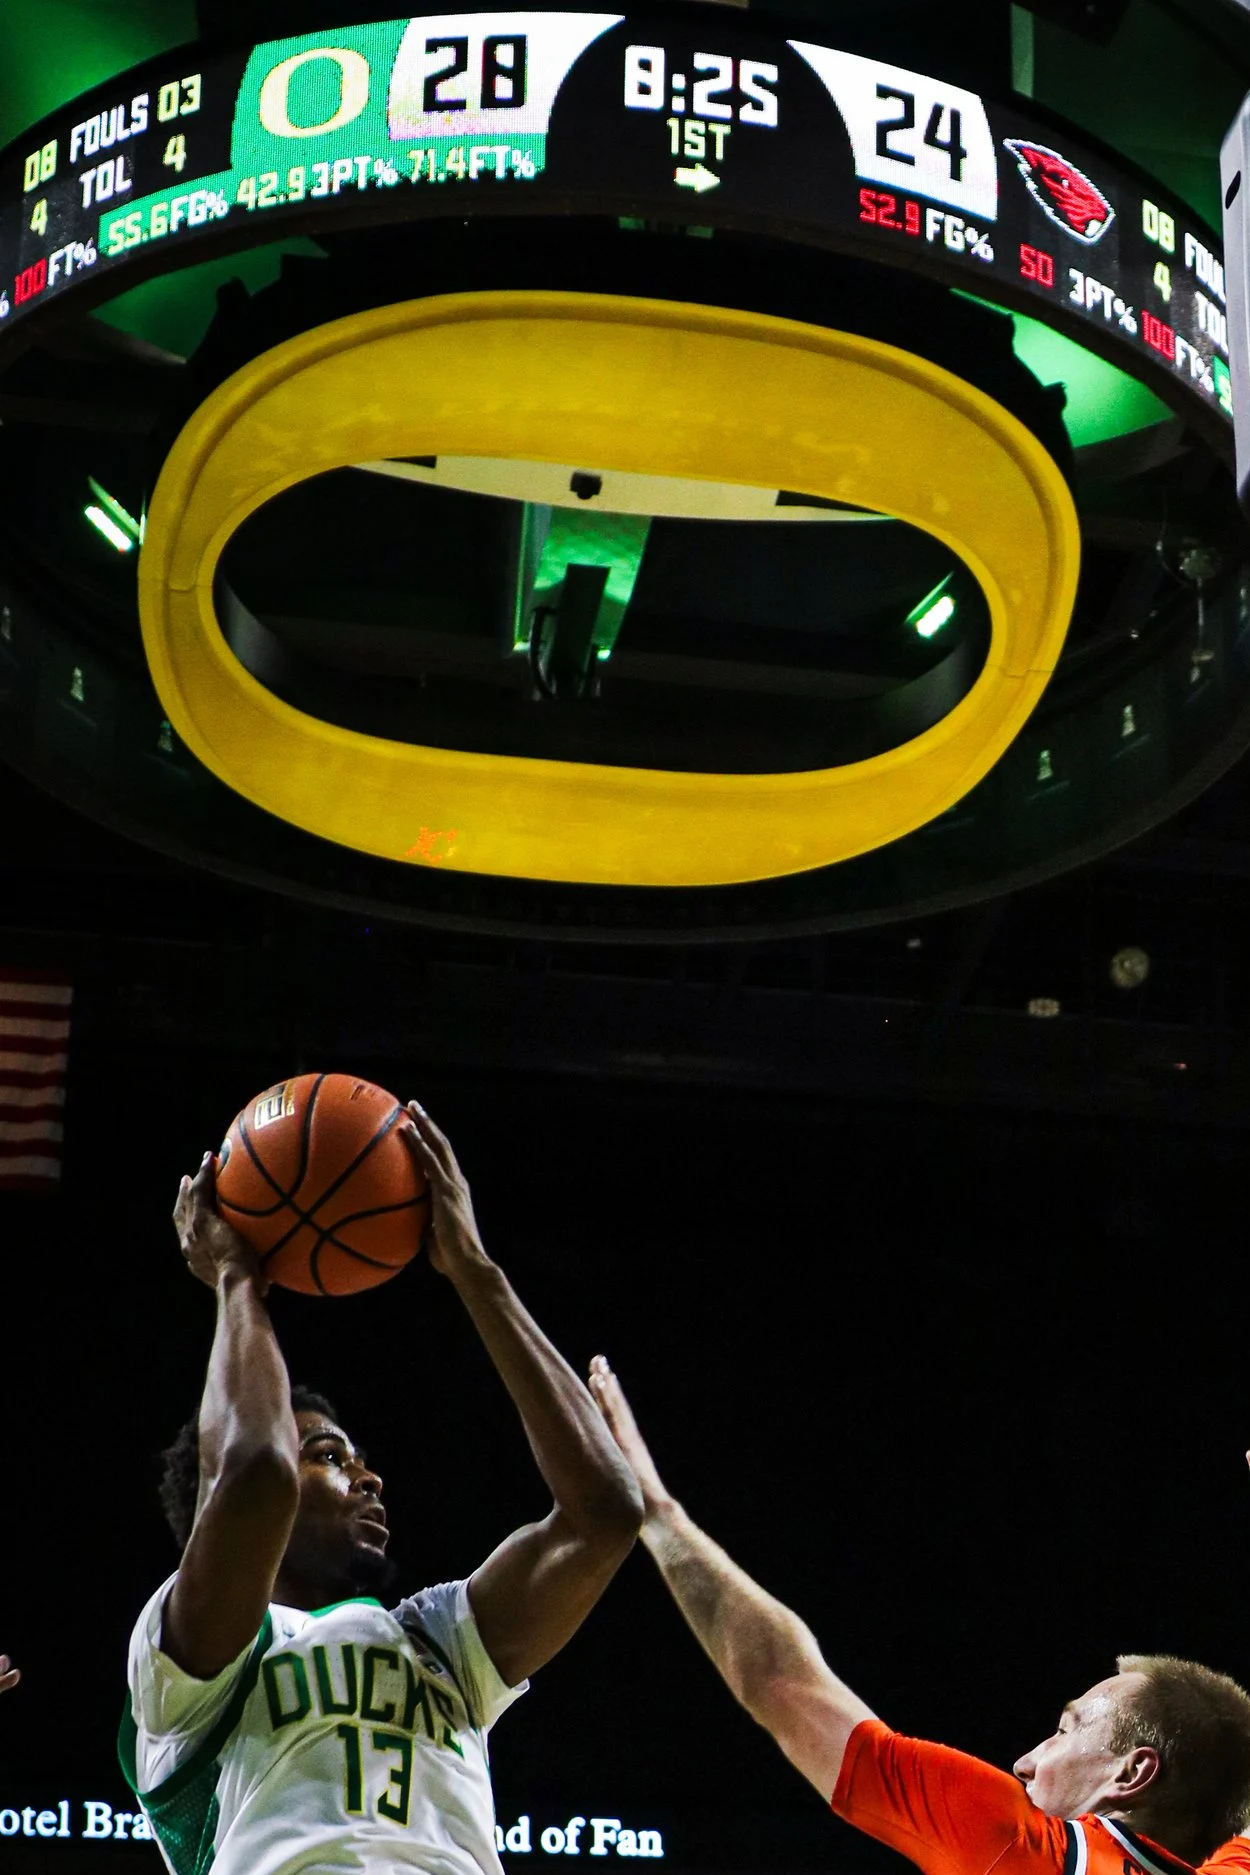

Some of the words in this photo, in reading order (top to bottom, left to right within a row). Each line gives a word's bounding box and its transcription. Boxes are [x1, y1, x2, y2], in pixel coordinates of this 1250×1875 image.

[422, 34, 528, 113] 28
[625, 45, 779, 127] 8:25
[69, 93, 149, 164] FOULS
[157, 74, 201, 122] 03
[667, 117, 732, 161] 1ST
[875, 82, 967, 182] 24
[30, 198, 48, 236] 4
[79, 155, 132, 209] TOL
[163, 133, 187, 173] 4
[859, 187, 920, 237] 52.9
[926, 207, 995, 263] FG%
[1020, 243, 1054, 289] 50
[1069, 267, 1138, 335] 3PT%
[1154, 261, 1172, 302] 4
[336, 1720, 416, 1829] 13
[0, 1799, 71, 1838] otel
[541, 1816, 586, 1855] of
[589, 1818, 664, 1858] Fan
